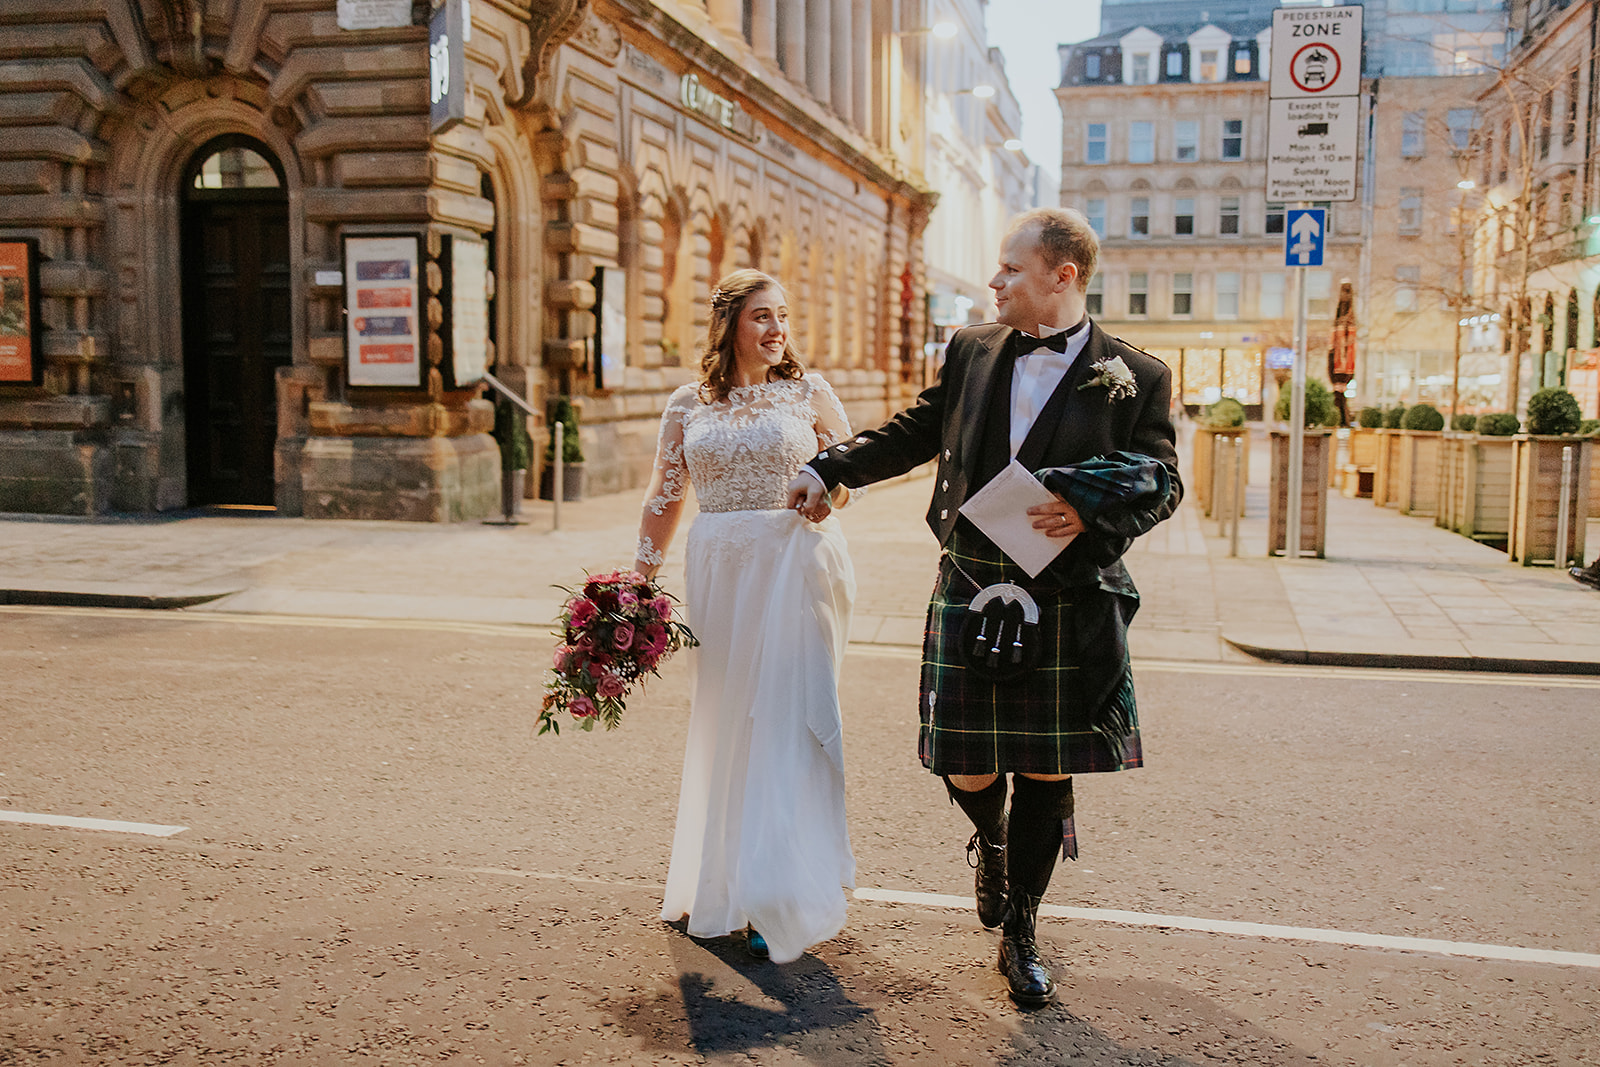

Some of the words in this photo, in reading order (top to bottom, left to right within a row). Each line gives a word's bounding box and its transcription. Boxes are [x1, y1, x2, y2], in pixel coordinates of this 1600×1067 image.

[1282, 10, 1353, 21] PEDESTRIAN
[1292, 23, 1341, 37] ZONE
[1288, 102, 1322, 110] Except
[1325, 101, 1340, 109] for
[1287, 112, 1324, 121] loading
[1327, 111, 1339, 120] by
[1288, 144, 1311, 152] Mon
[1318, 143, 1336, 151] Sat
[1271, 155, 1315, 164] Midnight
[1323, 154, 1336, 162] 10
[1293, 167, 1330, 176] Sunday
[1271, 179, 1315, 188] Midnight
[1323, 179, 1350, 187] Noon
[1304, 189, 1348, 197] Midnight
